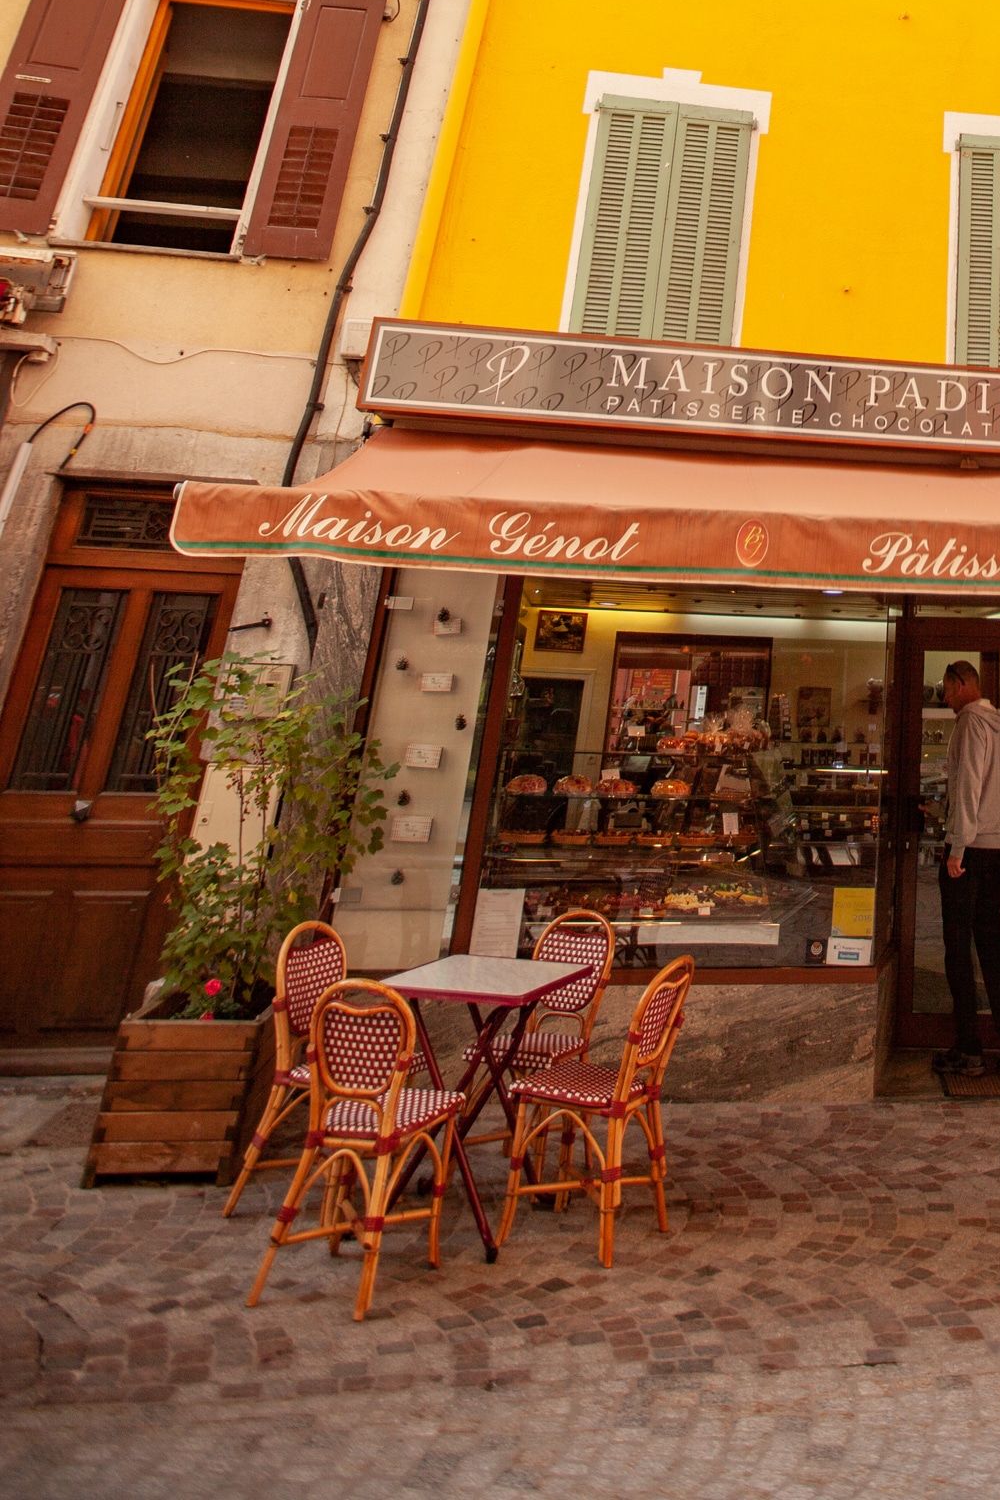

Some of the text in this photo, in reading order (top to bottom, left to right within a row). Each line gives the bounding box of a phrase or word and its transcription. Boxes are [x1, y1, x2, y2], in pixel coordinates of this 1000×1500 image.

[607, 354, 836, 403] MAISON
[258, 493, 641, 562] Maison Génot
[853, 914, 872, 923] 2016
